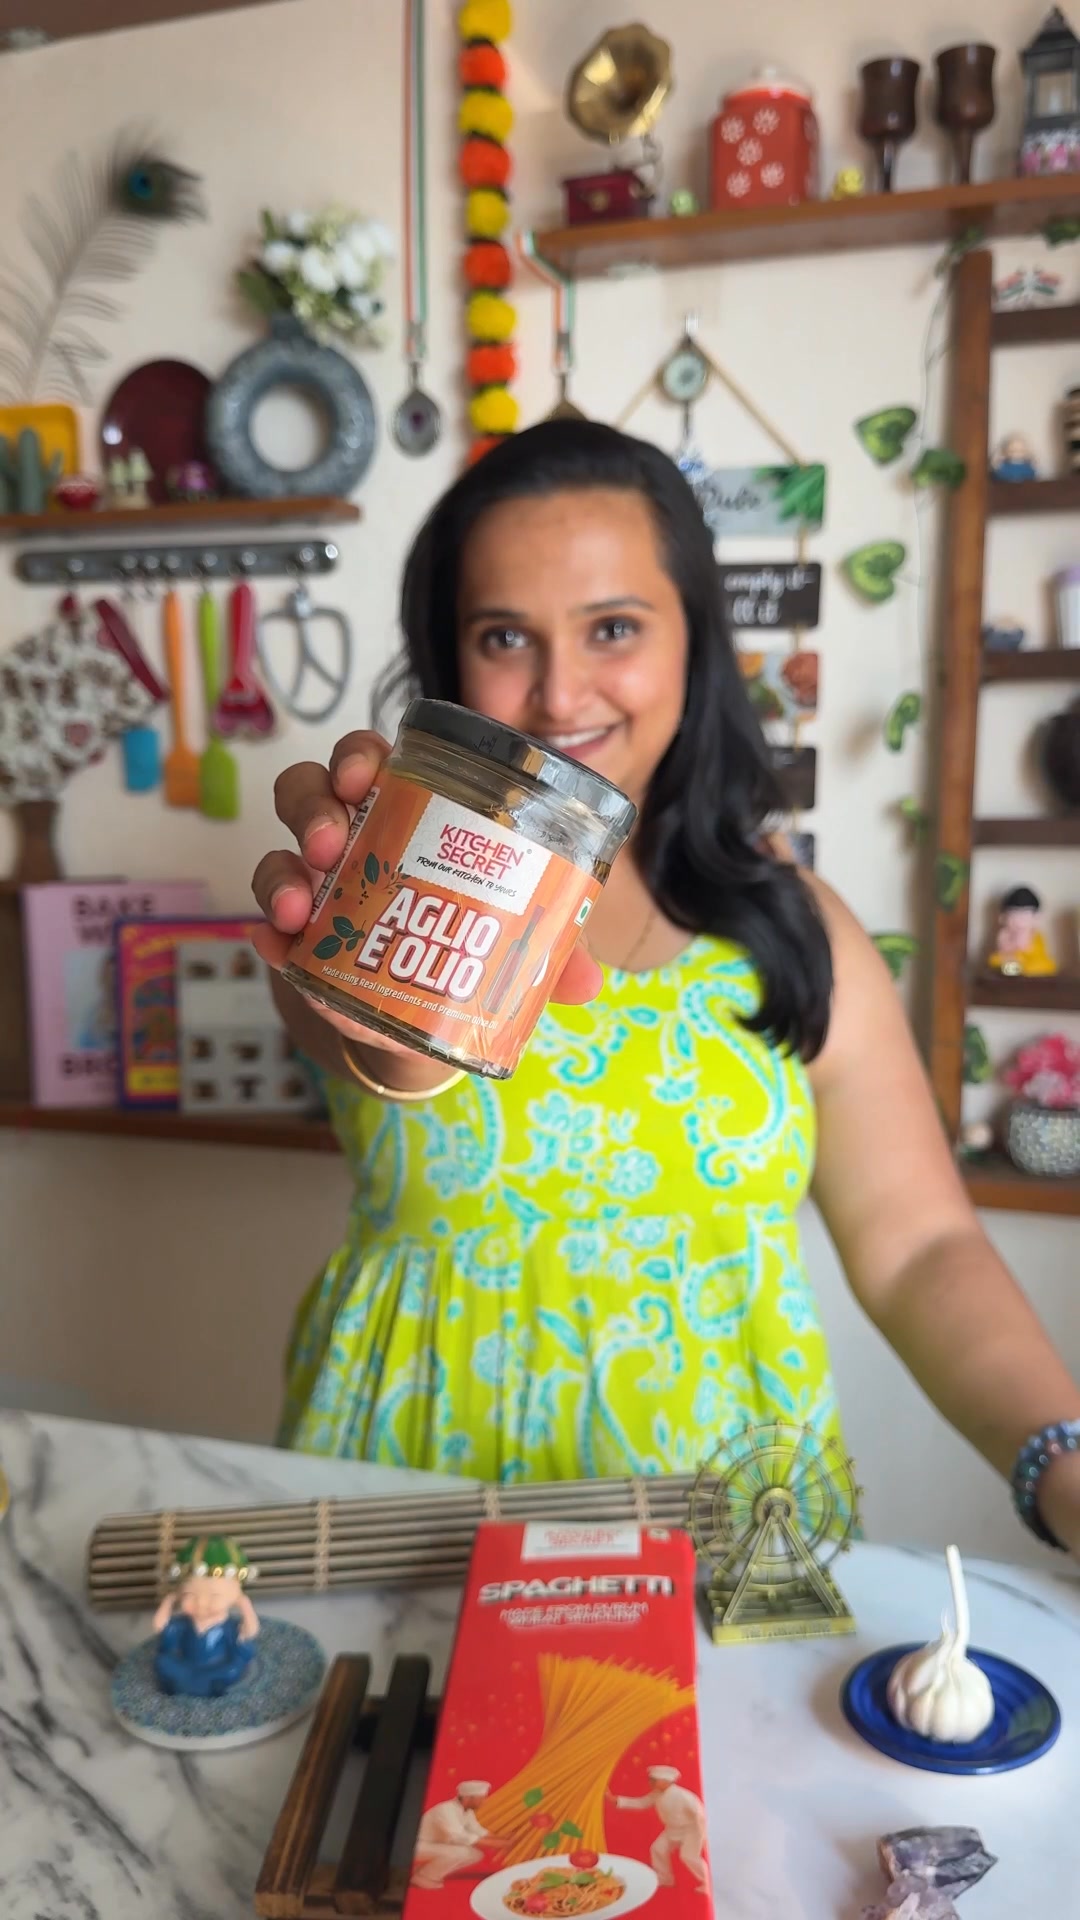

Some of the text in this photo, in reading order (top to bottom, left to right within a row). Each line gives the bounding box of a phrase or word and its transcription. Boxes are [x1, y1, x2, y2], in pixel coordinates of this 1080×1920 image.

[437, 842, 511, 880] SECRET
[440, 823, 524, 866] KITCHEN
[416, 856, 517, 898] FROM OUR KITCHEN TO YOURS
[376, 885, 502, 960] AGLIO
[355, 922, 486, 1002] E OLIO
[321, 965, 340, 979] Made
[339, 972, 359, 986] using
[359, 979, 376, 991] Real
[376, 983, 422, 1007] Ingredients
[422, 1001, 437, 1012] and
[438, 1005, 475, 1023] Premium
[478, 1574, 674, 1605] SPAGHETTI
